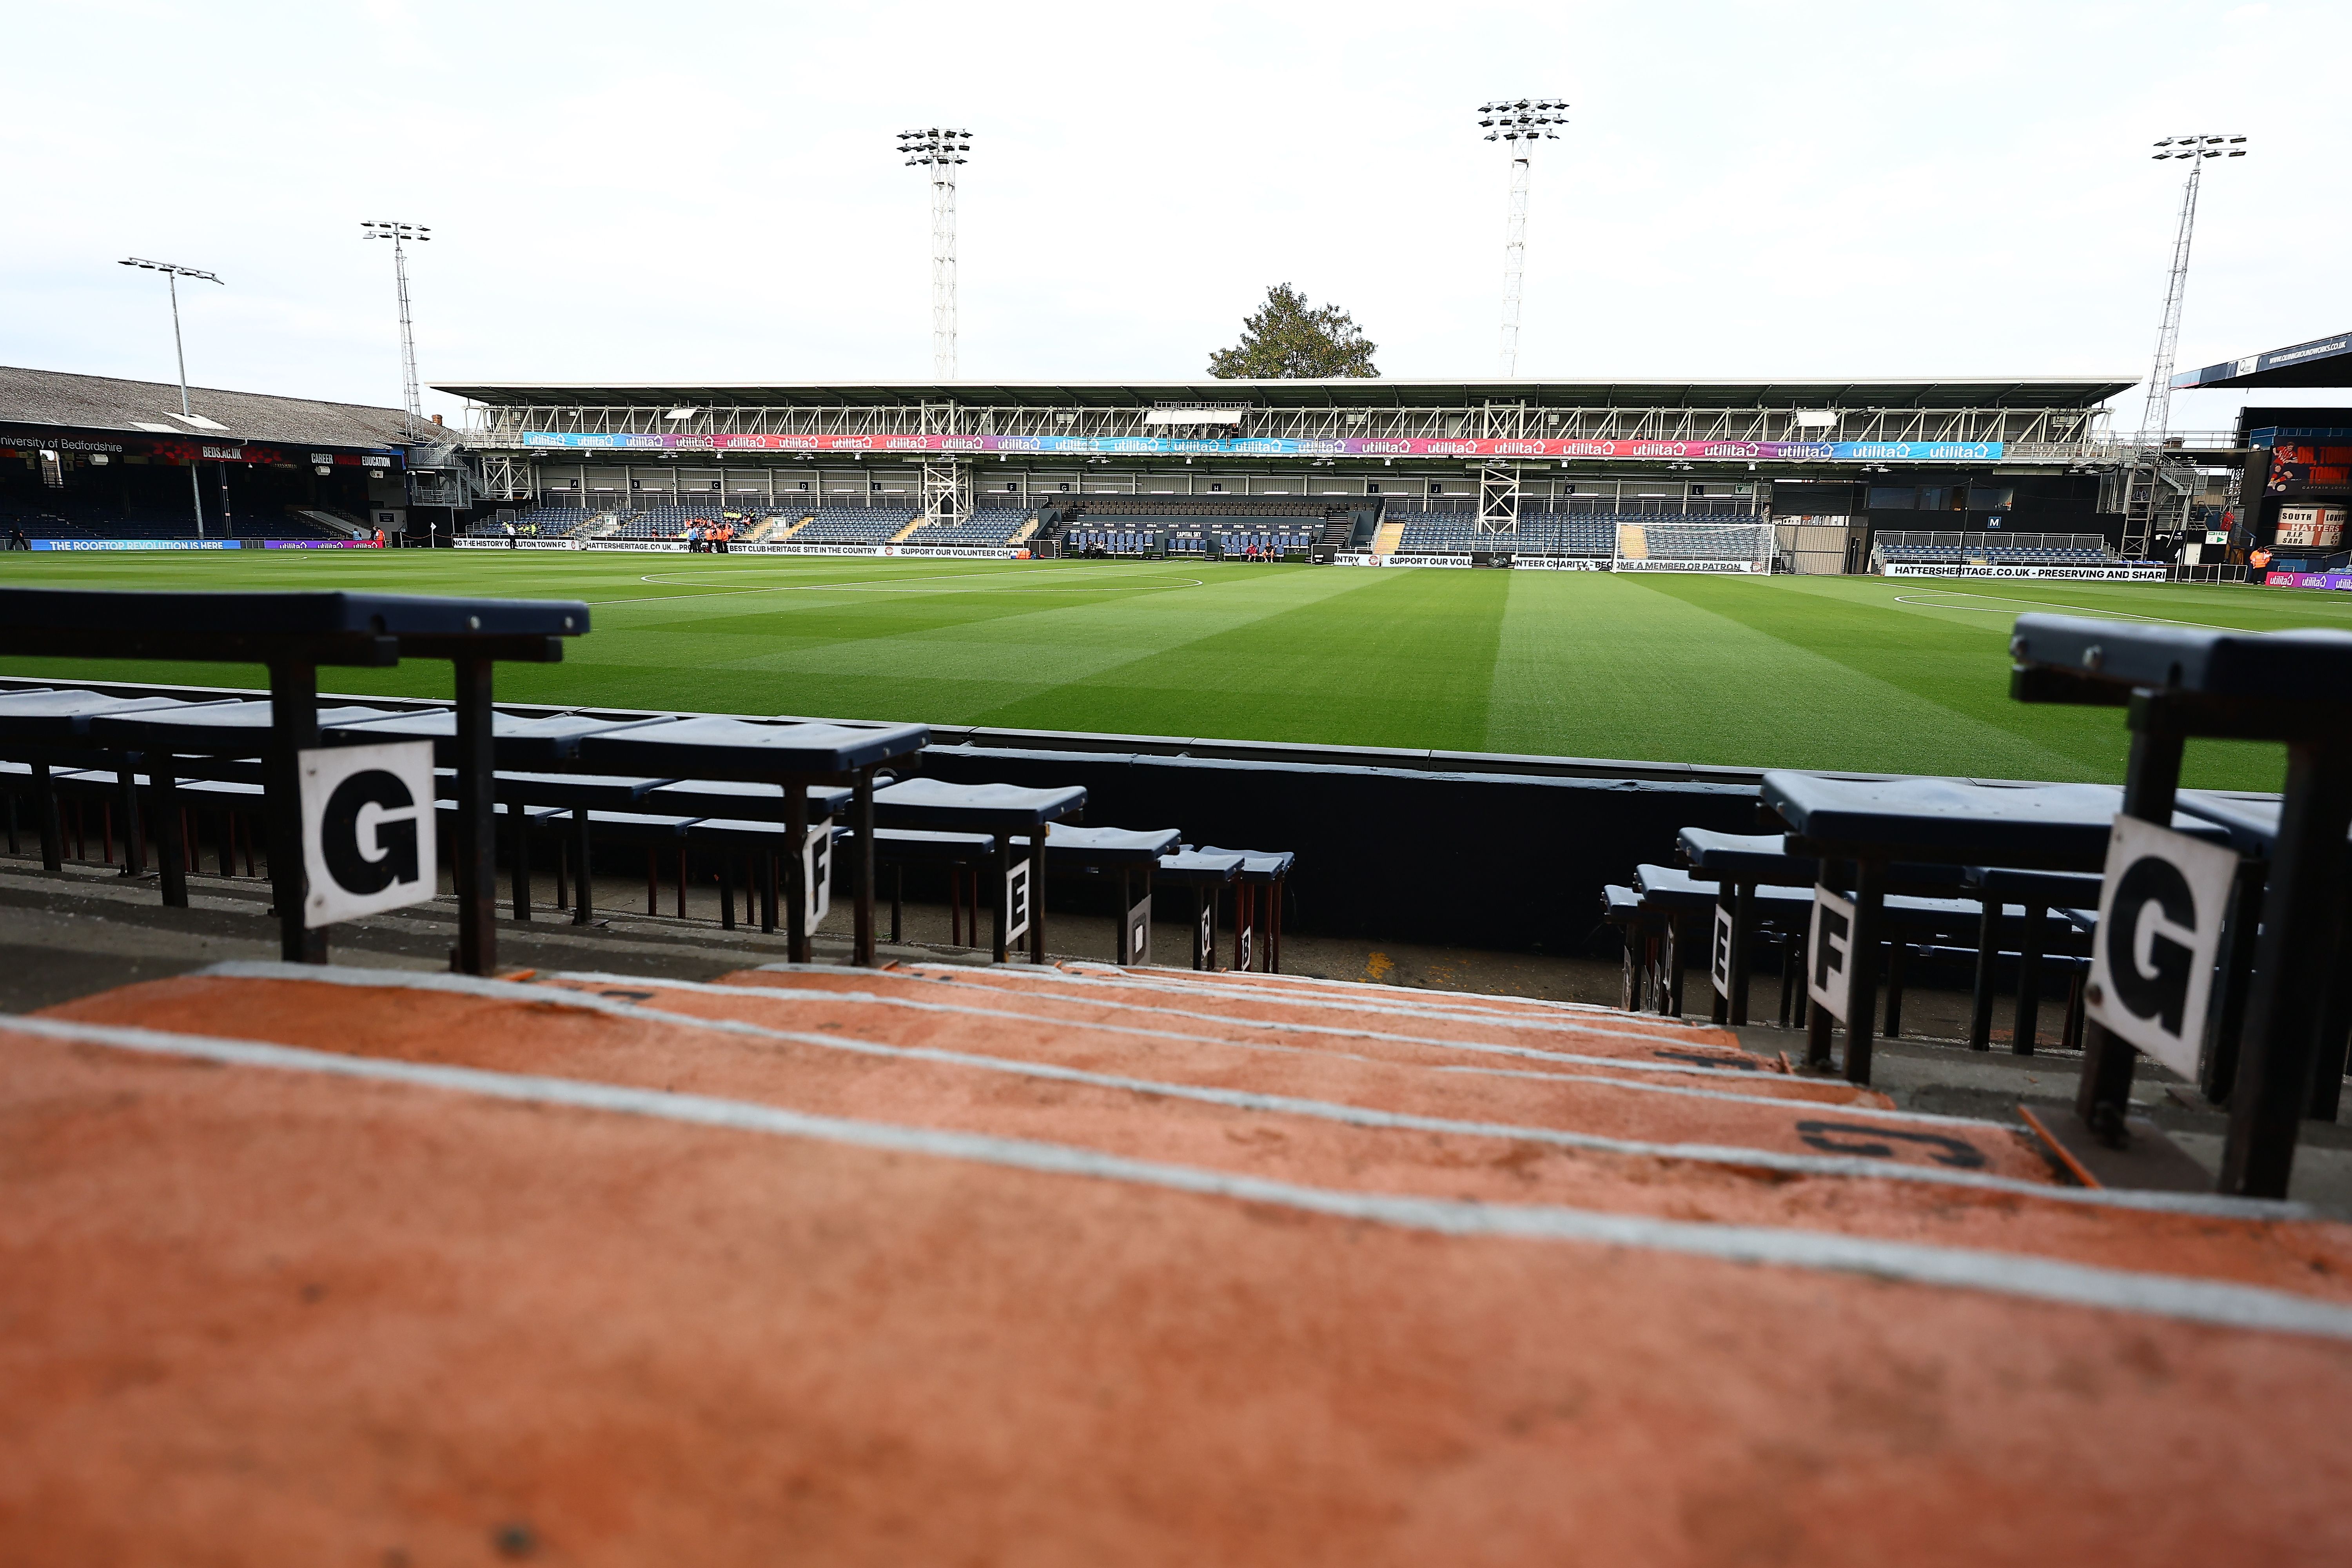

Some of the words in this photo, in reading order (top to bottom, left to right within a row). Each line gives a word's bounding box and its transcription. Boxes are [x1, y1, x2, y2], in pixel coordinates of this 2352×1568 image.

[0, 436, 45, 449] niversity
[48, 438, 59, 448] of
[61, 439, 122, 452] Bedfordshire
[529, 435, 556, 445] utilita
[577, 436, 604, 446] utilita
[626, 436, 653, 446] utilita
[676, 437, 705, 447] utilita
[727, 437, 756, 447] utilita
[779, 437, 808, 448] utilita
[832, 438, 862, 448] utilita
[886, 438, 917, 448] utilita
[942, 438, 972, 449] utilita
[998, 438, 1030, 450] utilita
[1055, 439, 1087, 450] utilita
[1114, 440, 1147, 451] utilita
[203, 446, 242, 459] BEDS.AC.UK
[1174, 441, 1208, 452] utilita
[1236, 441, 1270, 452] utilita
[1298, 441, 1333, 452] utilita
[1362, 441, 1398, 453] utilita
[1428, 442, 1465, 453] utilita
[1495, 442, 1532, 454] utilita
[1563, 443, 1601, 455] utilita
[1633, 444, 1672, 456] utilita
[1704, 444, 1744, 456] utilita
[1778, 445, 1819, 457] utilita
[1853, 445, 1895, 457] utilita
[1930, 446, 1973, 458] utilita
[311, 453, 333, 464] CAREER
[362, 456, 390, 467] EDUCATION
[2309, 466, 2350, 484] TOMMY
[49, 541, 72, 550] THE
[73, 541, 124, 550] ROOFTOP
[127, 541, 189, 550] REVOLUTION
[1895, 566, 2030, 576] HATTERSHERITAGE.CO.UK
[2038, 569, 2104, 578] PRESERVING
[2270, 575, 2288, 585] utilita
[2302, 577, 2321, 587] utilita
[321, 769, 419, 895] G
[812, 834, 828, 915] F
[1011, 871, 1026, 938] E
[1203, 915, 1209, 951] C
[1243, 934, 1249, 967] B
[1714, 917, 1728, 984] E
[1814, 904, 1848, 991] F
[2108, 856, 2196, 1038] G
